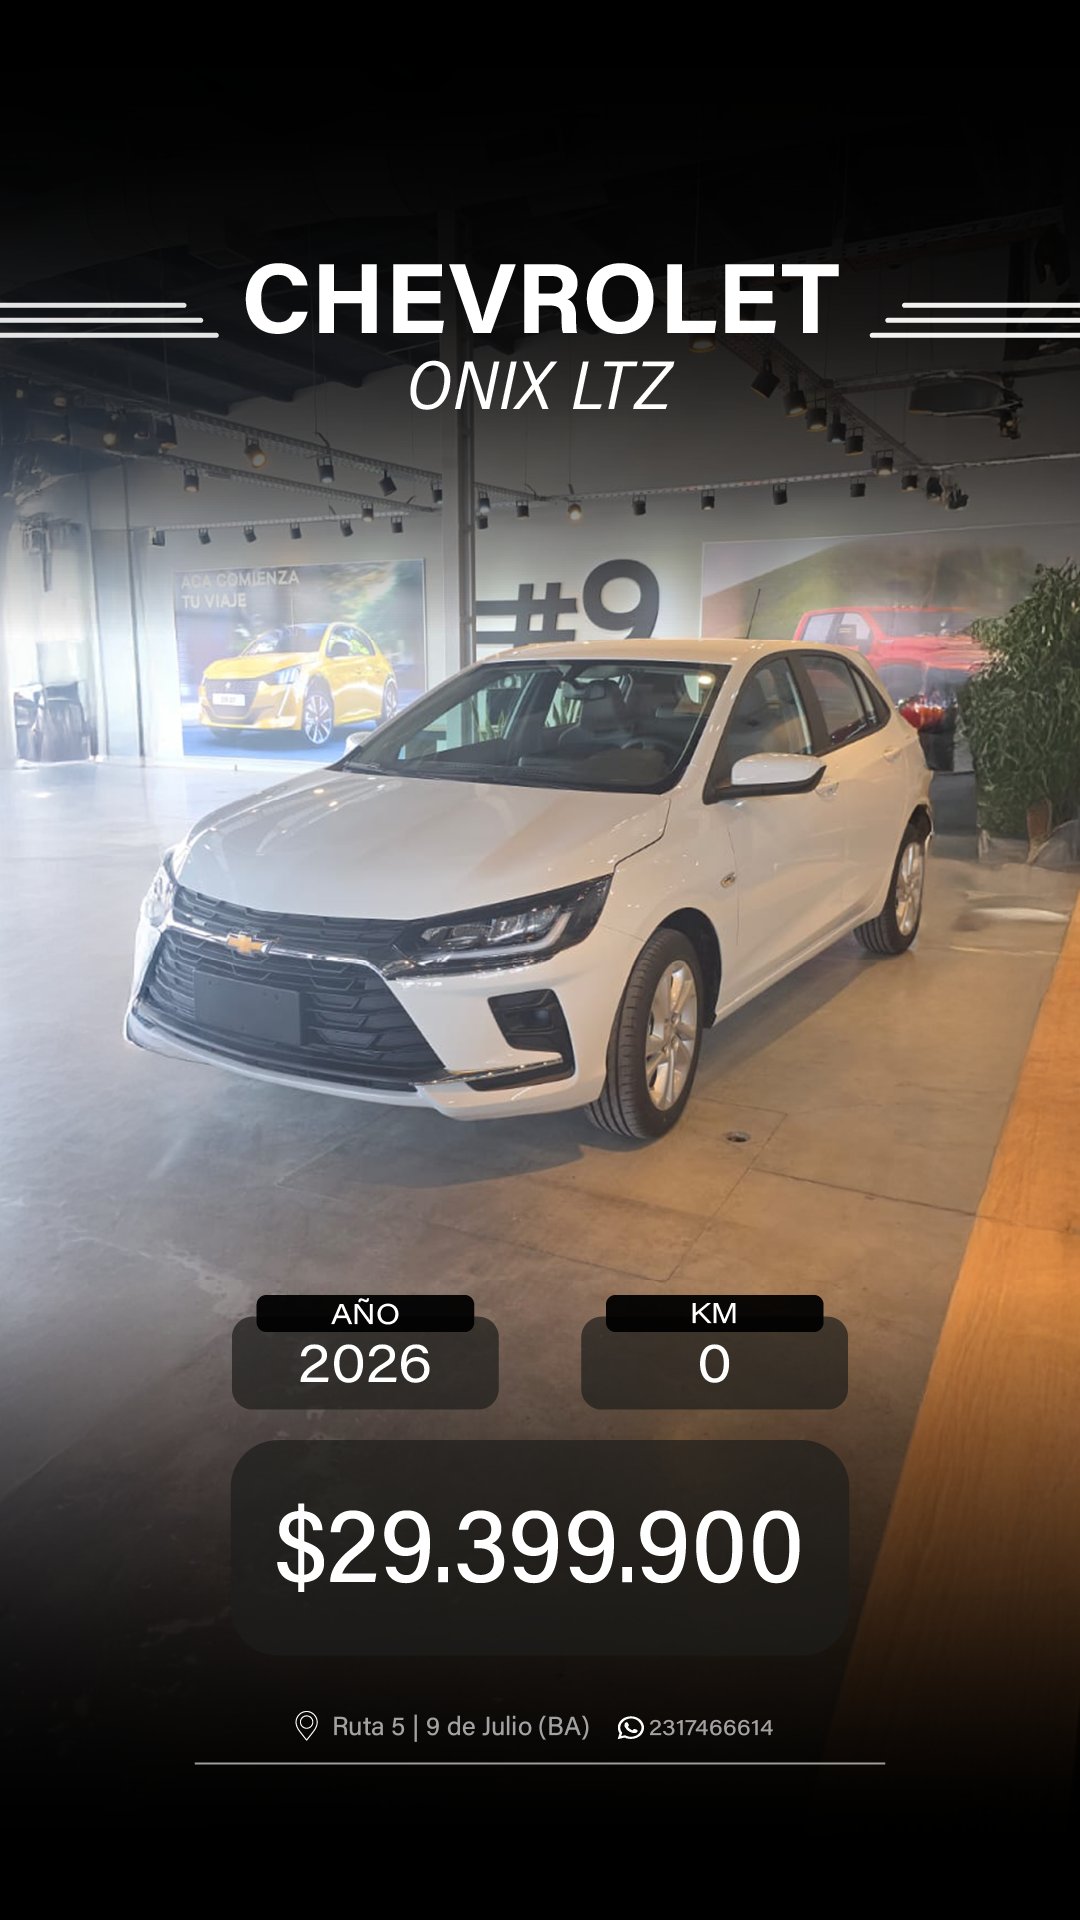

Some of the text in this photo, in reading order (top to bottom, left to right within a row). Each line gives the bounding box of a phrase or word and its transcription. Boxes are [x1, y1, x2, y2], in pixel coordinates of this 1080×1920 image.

[216, 569, 300, 588] COMIENZA
[181, 592, 247, 609] TU VIAJE
